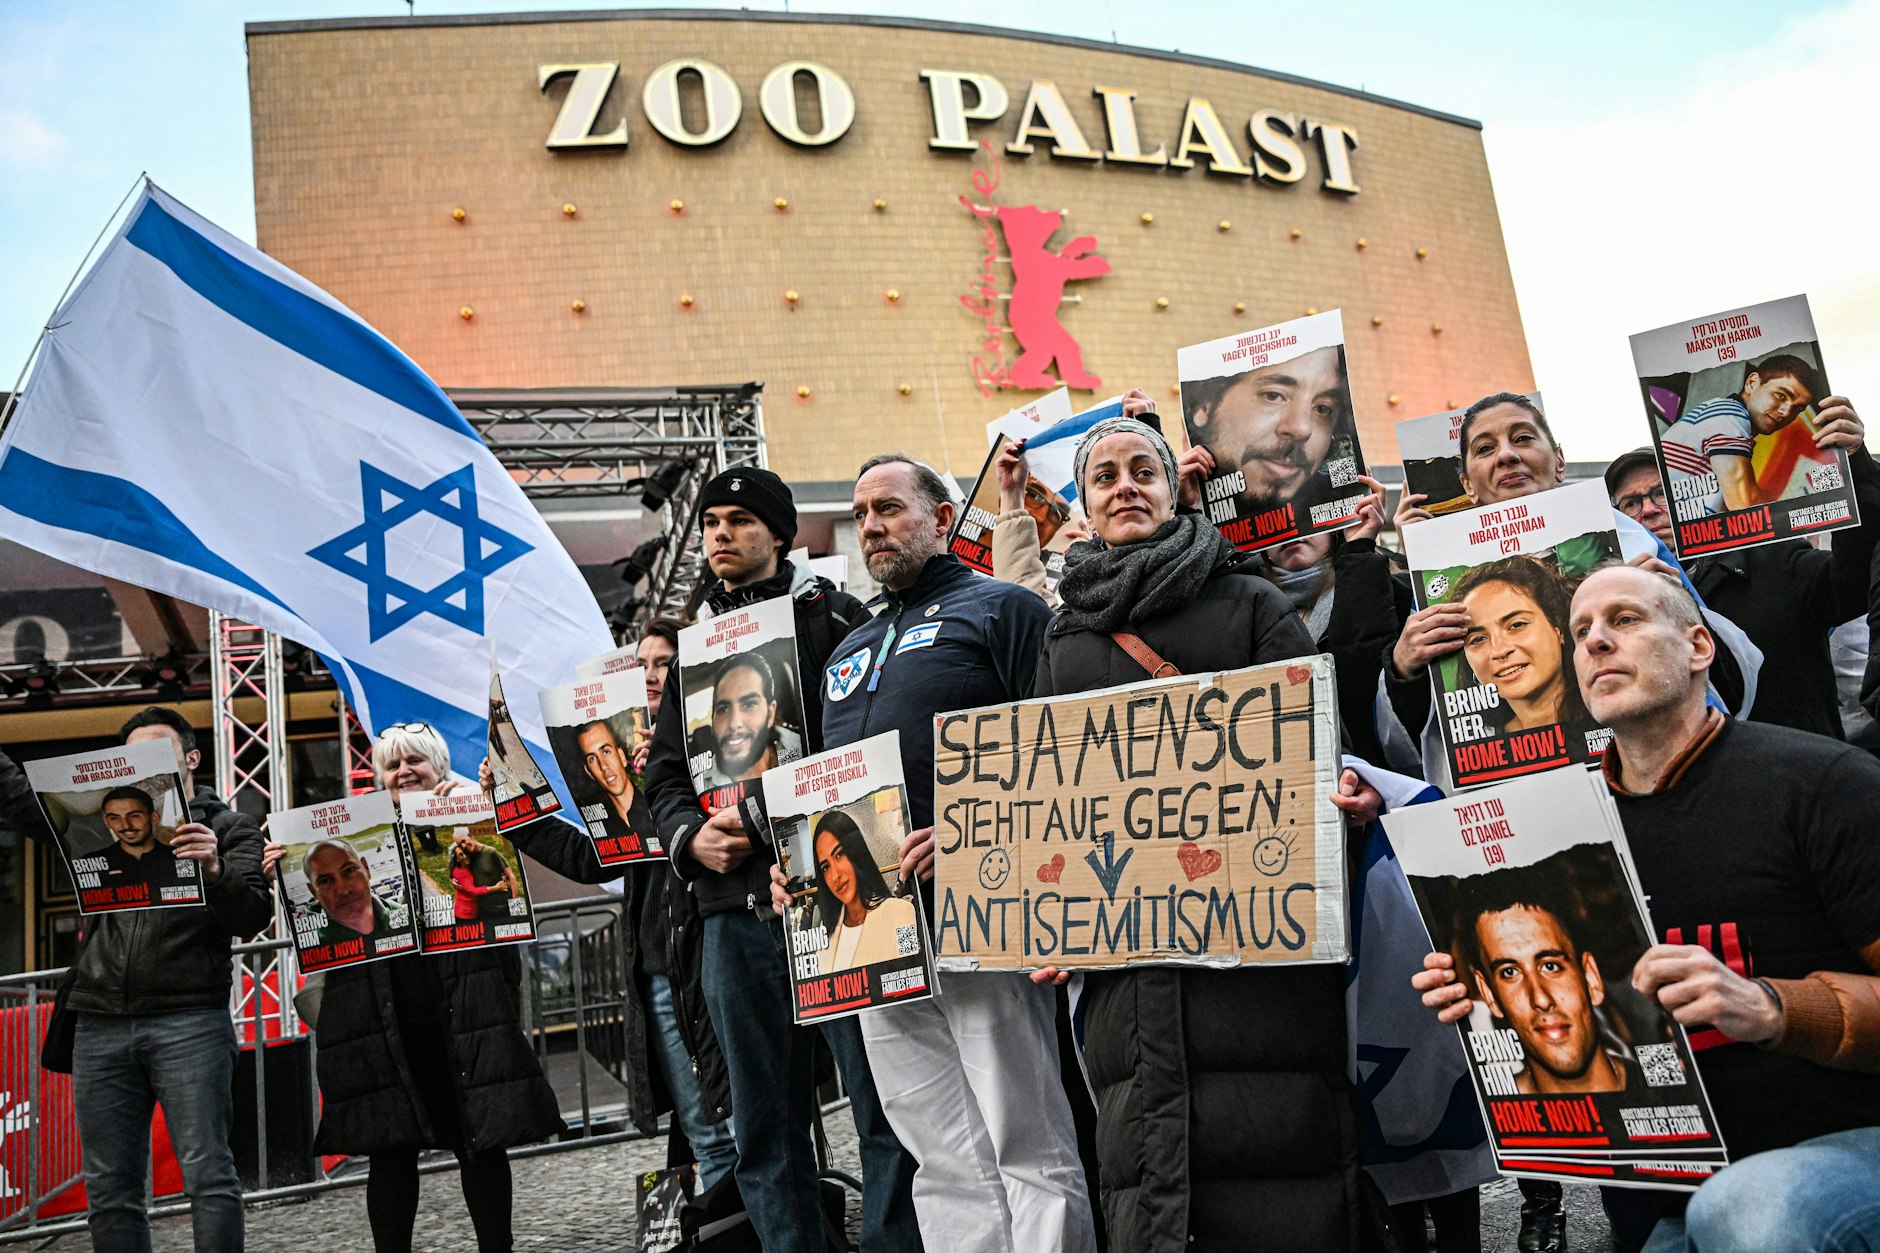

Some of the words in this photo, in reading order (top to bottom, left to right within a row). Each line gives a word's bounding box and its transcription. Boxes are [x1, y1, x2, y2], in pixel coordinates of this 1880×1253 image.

[538, 58, 856, 149] ZOO
[918, 69, 1361, 194] PALAST
[1692, 321, 1717, 339] הרקין
[1718, 314, 1749, 331] מקסים
[1222, 348, 1247, 363] YAGEV
[1249, 335, 1297, 356] BUCHSHTAB
[1685, 334, 1726, 354] MAKSYM
[1727, 325, 1762, 343] HARKIN
[1251, 353, 1269, 366] (35)
[1717, 345, 1736, 362] (35)
[1204, 470, 1247, 503] BRING
[1670, 474, 1719, 501] BRING
[1208, 497, 1237, 524] HIM
[1254, 503, 1297, 536] NOW!
[1311, 507, 1342, 524] FAMILIES
[1342, 503, 1357, 517] FOR
[1479, 511, 1503, 529] הימן
[1503, 504, 1528, 521] ענבר
[1674, 499, 1707, 523] HIM
[1788, 506, 1814, 518] HOSTAGES
[1814, 504, 1825, 513] AND
[1824, 499, 1848, 511] MISSING
[1790, 512, 1822, 528] FAMILIES
[1822, 506, 1850, 522] FORUM
[958, 520, 983, 542] HIM
[1469, 528, 1500, 545] INBAR
[1501, 516, 1545, 537] HAYMAN
[1680, 517, 1724, 546] HOME
[1727, 506, 1773, 537] NOW!
[951, 537, 984, 561] HOME
[1500, 537, 1520, 555] (27)
[706, 633, 724, 648] MATAN
[725, 621, 759, 641] ZANGAUKER
[726, 639, 737, 654] (24)
[1443, 682, 1500, 718] BRING
[1448, 714, 1487, 744] HER
[844, 749, 863, 766] עמית
[1454, 739, 1509, 774] HOME
[1509, 724, 1567, 763] NOW!
[72, 774, 89, 784] ROM
[90, 765, 136, 781] BRASLAVSKI
[690, 750, 713, 777] BRING
[794, 761, 823, 782] בוסקילה
[823, 755, 843, 772] אסתר
[794, 781, 811, 797] AMIT
[811, 773, 837, 792] ESTHER
[837, 763, 868, 784] BUSKILA
[824, 787, 839, 805] (28)
[427, 807, 456, 817] WEINSTEIN
[456, 806, 468, 814] AND
[496, 800, 518, 823] HOME
[580, 802, 609, 822] BRING
[940, 797, 1043, 854] STEHT
[1124, 778, 1297, 841] GEGEN:
[1453, 803, 1486, 826] דניאל
[1483, 798, 1505, 819] עוז
[311, 818, 328, 830] ELAD
[328, 813, 351, 826] KATZIR
[588, 820, 608, 838] HIM
[1461, 828, 1478, 847] OZ
[1475, 819, 1515, 844] DANIEL
[595, 837, 621, 857] HOME
[617, 832, 642, 852] NOW!
[1482, 843, 1506, 867] (19)
[71, 856, 109, 874] BRING
[77, 872, 102, 889] HIM
[82, 887, 114, 905] HOME
[116, 882, 150, 901] NOW!
[423, 894, 454, 912] BRING
[294, 911, 329, 934] BRING
[425, 927, 453, 945] HOME
[455, 921, 486, 941] NOW!
[297, 930, 320, 949] HIM
[792, 925, 829, 956] BRING
[301, 945, 332, 967] HOME
[334, 936, 365, 959] NOW!
[795, 953, 820, 981] HER
[797, 978, 832, 1008] HOME
[833, 967, 870, 1003] NOW!
[881, 979, 906, 995] FAMILIES
[905, 975, 926, 990] FORUM
[1467, 1027, 1525, 1062] BRING
[1478, 1064, 1519, 1096] HIM
[1490, 1100, 1547, 1133] HOME
[1542, 1094, 1604, 1132] NOW!
[1619, 1107, 1655, 1120] HOSTAGES
[1653, 1106, 1669, 1118] AND
[1667, 1104, 1701, 1117] MISSING
[1623, 1118, 1670, 1136] FAMILIES
[1667, 1116, 1708, 1135] FORUM
